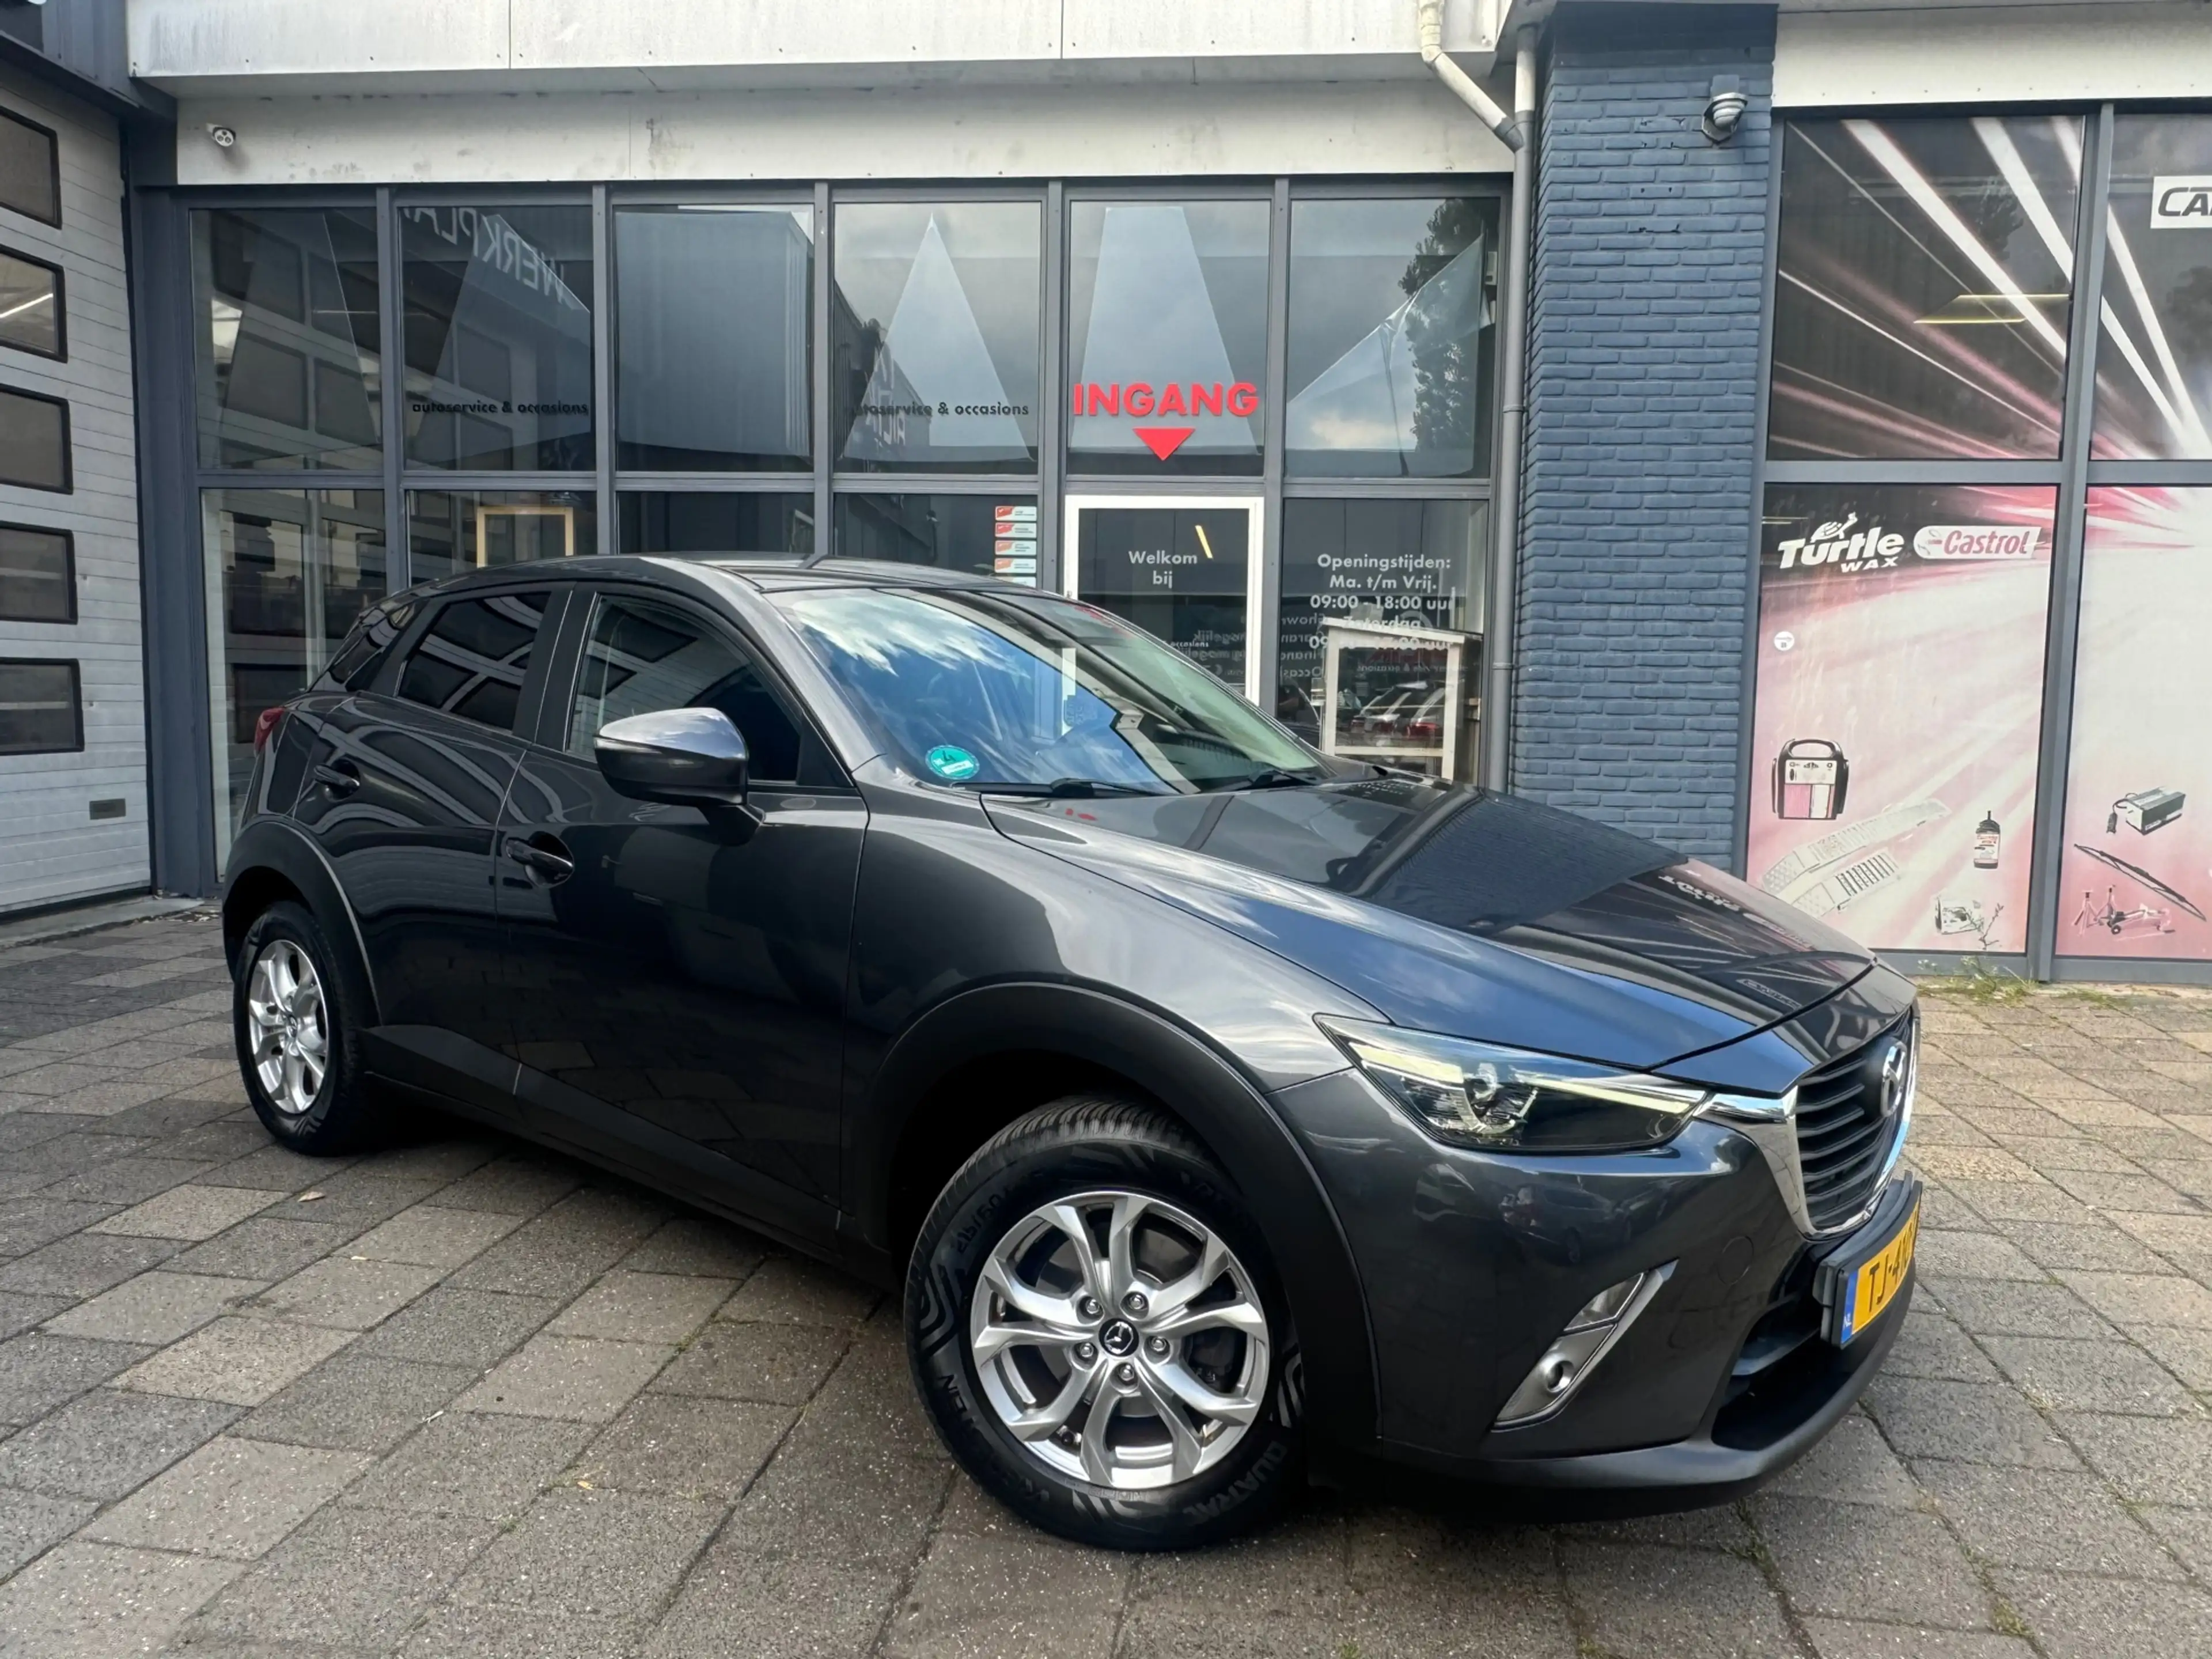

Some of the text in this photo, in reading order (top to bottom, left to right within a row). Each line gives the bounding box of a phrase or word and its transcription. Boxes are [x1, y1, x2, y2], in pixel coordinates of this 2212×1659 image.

[2158, 187, 2212, 216] CA
[412, 399, 589, 415] autoservice & occasions
[1073, 382, 1260, 417] INGANG
[937, 402, 949, 415] &
[955, 402, 1029, 415] occasions
[1778, 527, 1904, 569] Turtle
[1943, 529, 2031, 555] Castrol
[1128, 551, 1198, 565] Welkom
[1317, 554, 1451, 572] Openingstijden:
[1841, 556, 1899, 573] WAX
[1153, 571, 1173, 588] bij
[1330, 574, 1437, 593] Ma. t/m Vrij.
[1310, 594, 1358, 609] 09:00
[1375, 596, 1422, 609] 18:00
